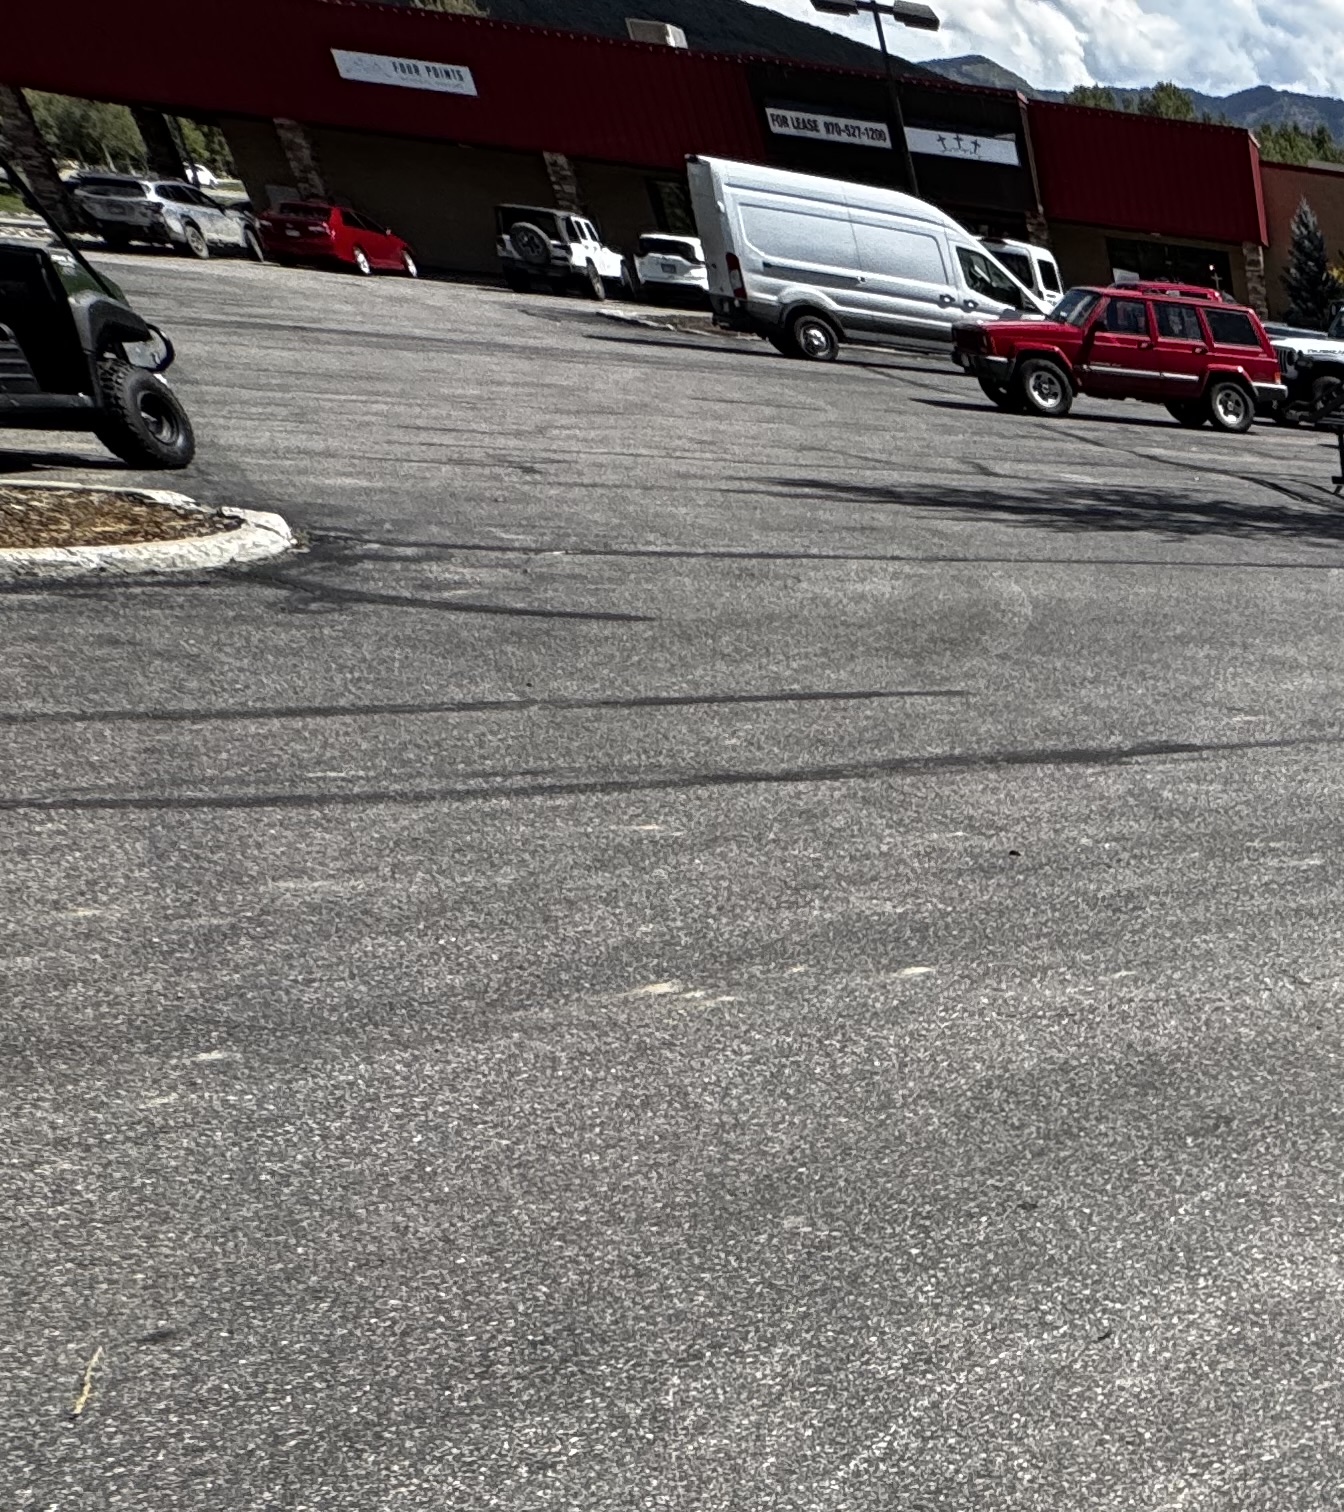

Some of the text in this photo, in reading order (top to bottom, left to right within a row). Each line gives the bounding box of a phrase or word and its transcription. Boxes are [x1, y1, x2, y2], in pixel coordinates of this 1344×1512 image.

[425, 65, 464, 82] POINTS
[769, 112, 790, 129] FOR
[792, 117, 821, 133] LEASE
